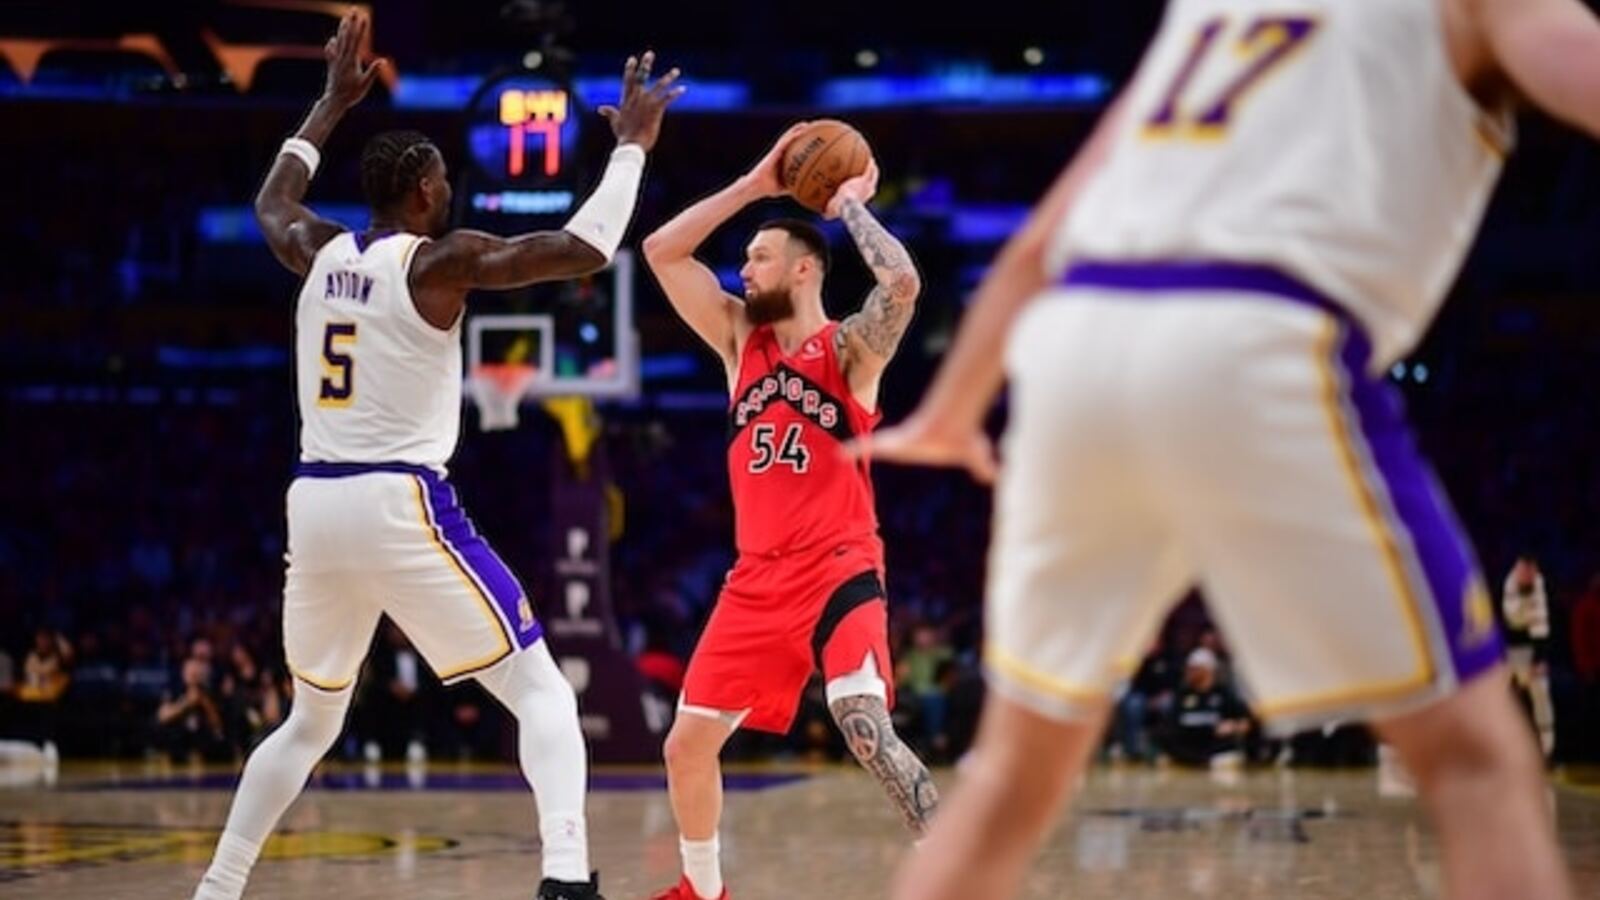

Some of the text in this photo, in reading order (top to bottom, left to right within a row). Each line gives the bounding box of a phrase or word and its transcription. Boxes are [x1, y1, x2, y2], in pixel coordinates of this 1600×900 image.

[1140, 13, 1320, 139] 17
[324, 270, 375, 305] AYTON
[317, 321, 357, 408] 5
[749, 422, 809, 474] 54
